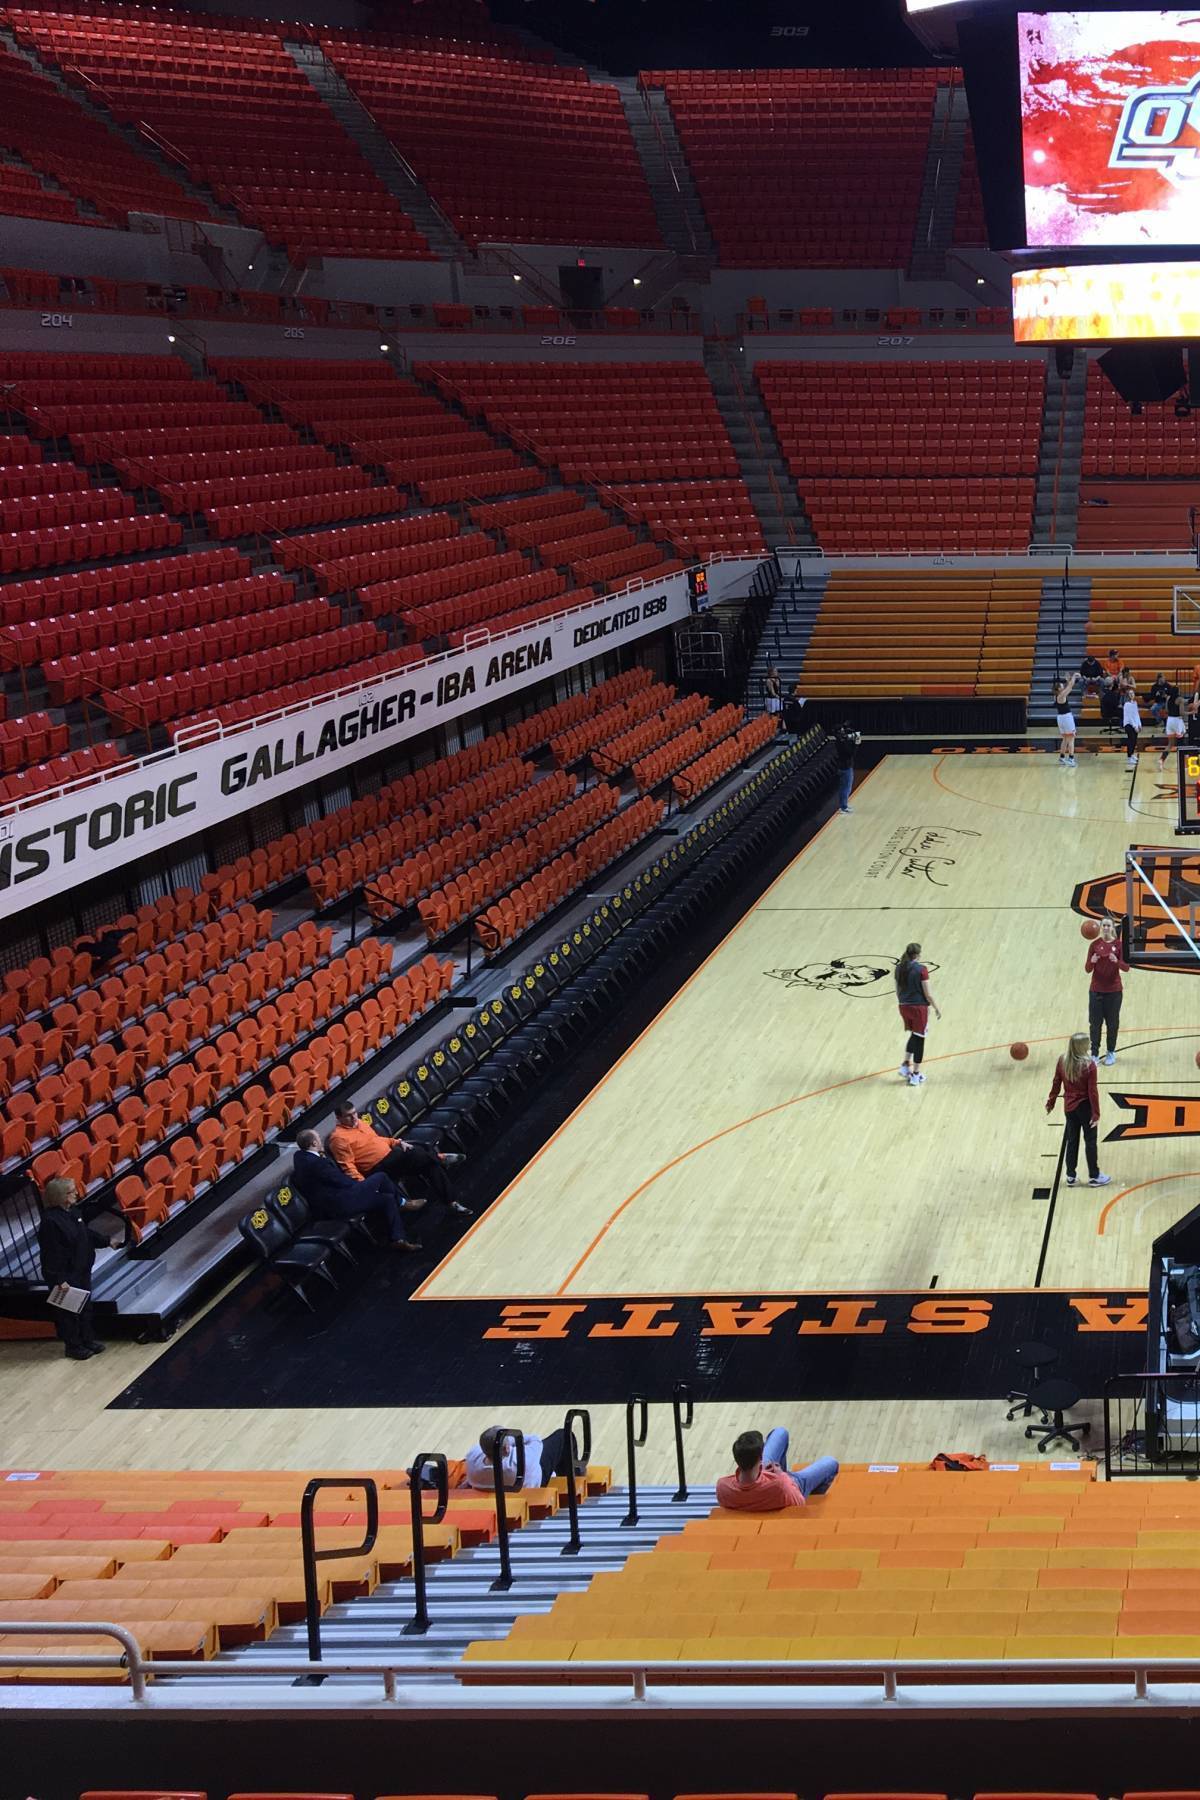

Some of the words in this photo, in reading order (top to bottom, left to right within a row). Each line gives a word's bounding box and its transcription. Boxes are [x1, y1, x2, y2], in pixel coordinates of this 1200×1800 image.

[41, 313, 73, 327] 204
[541, 336, 577, 345] 206
[878, 336, 914, 345] 207
[573, 605, 640, 648] DEDICATED
[642, 595, 668, 620] 1938
[0, 771, 198, 892] ISTORIC
[220, 665, 477, 798] GALLAGHER-IBA
[484, 636, 554, 687] ARENA
[481, 1299, 993, 1340] STATE
